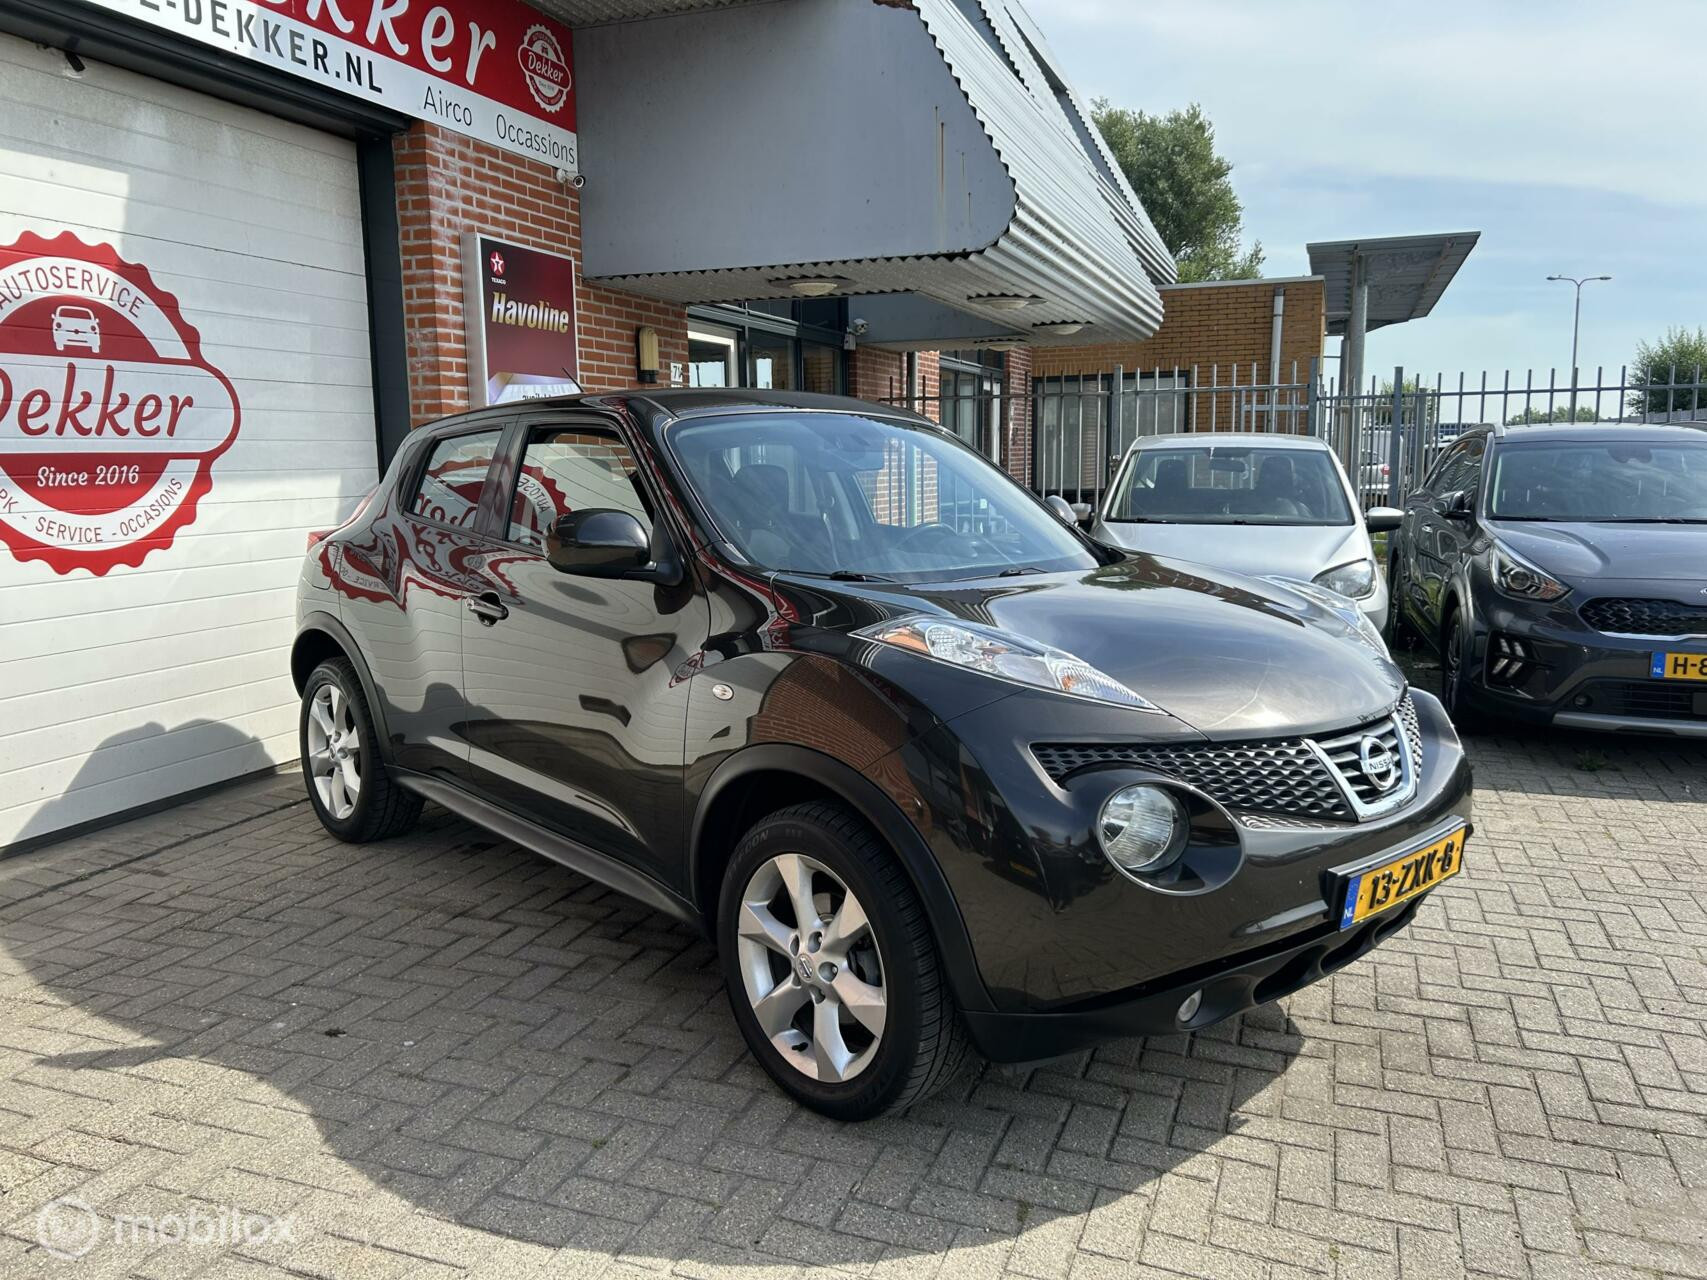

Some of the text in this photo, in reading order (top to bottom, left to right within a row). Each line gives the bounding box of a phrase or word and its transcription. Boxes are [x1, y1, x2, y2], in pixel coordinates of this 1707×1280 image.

[528, 51, 564, 82] Dekker
[424, 86, 575, 164] Airco Occassions
[492, 292, 570, 334] Havoline
[0, 362, 194, 437] ekker
[37, 465, 139, 486] Since 2016
[36, 516, 103, 543] SERVICE
[1343, 907, 1353, 920] NL
